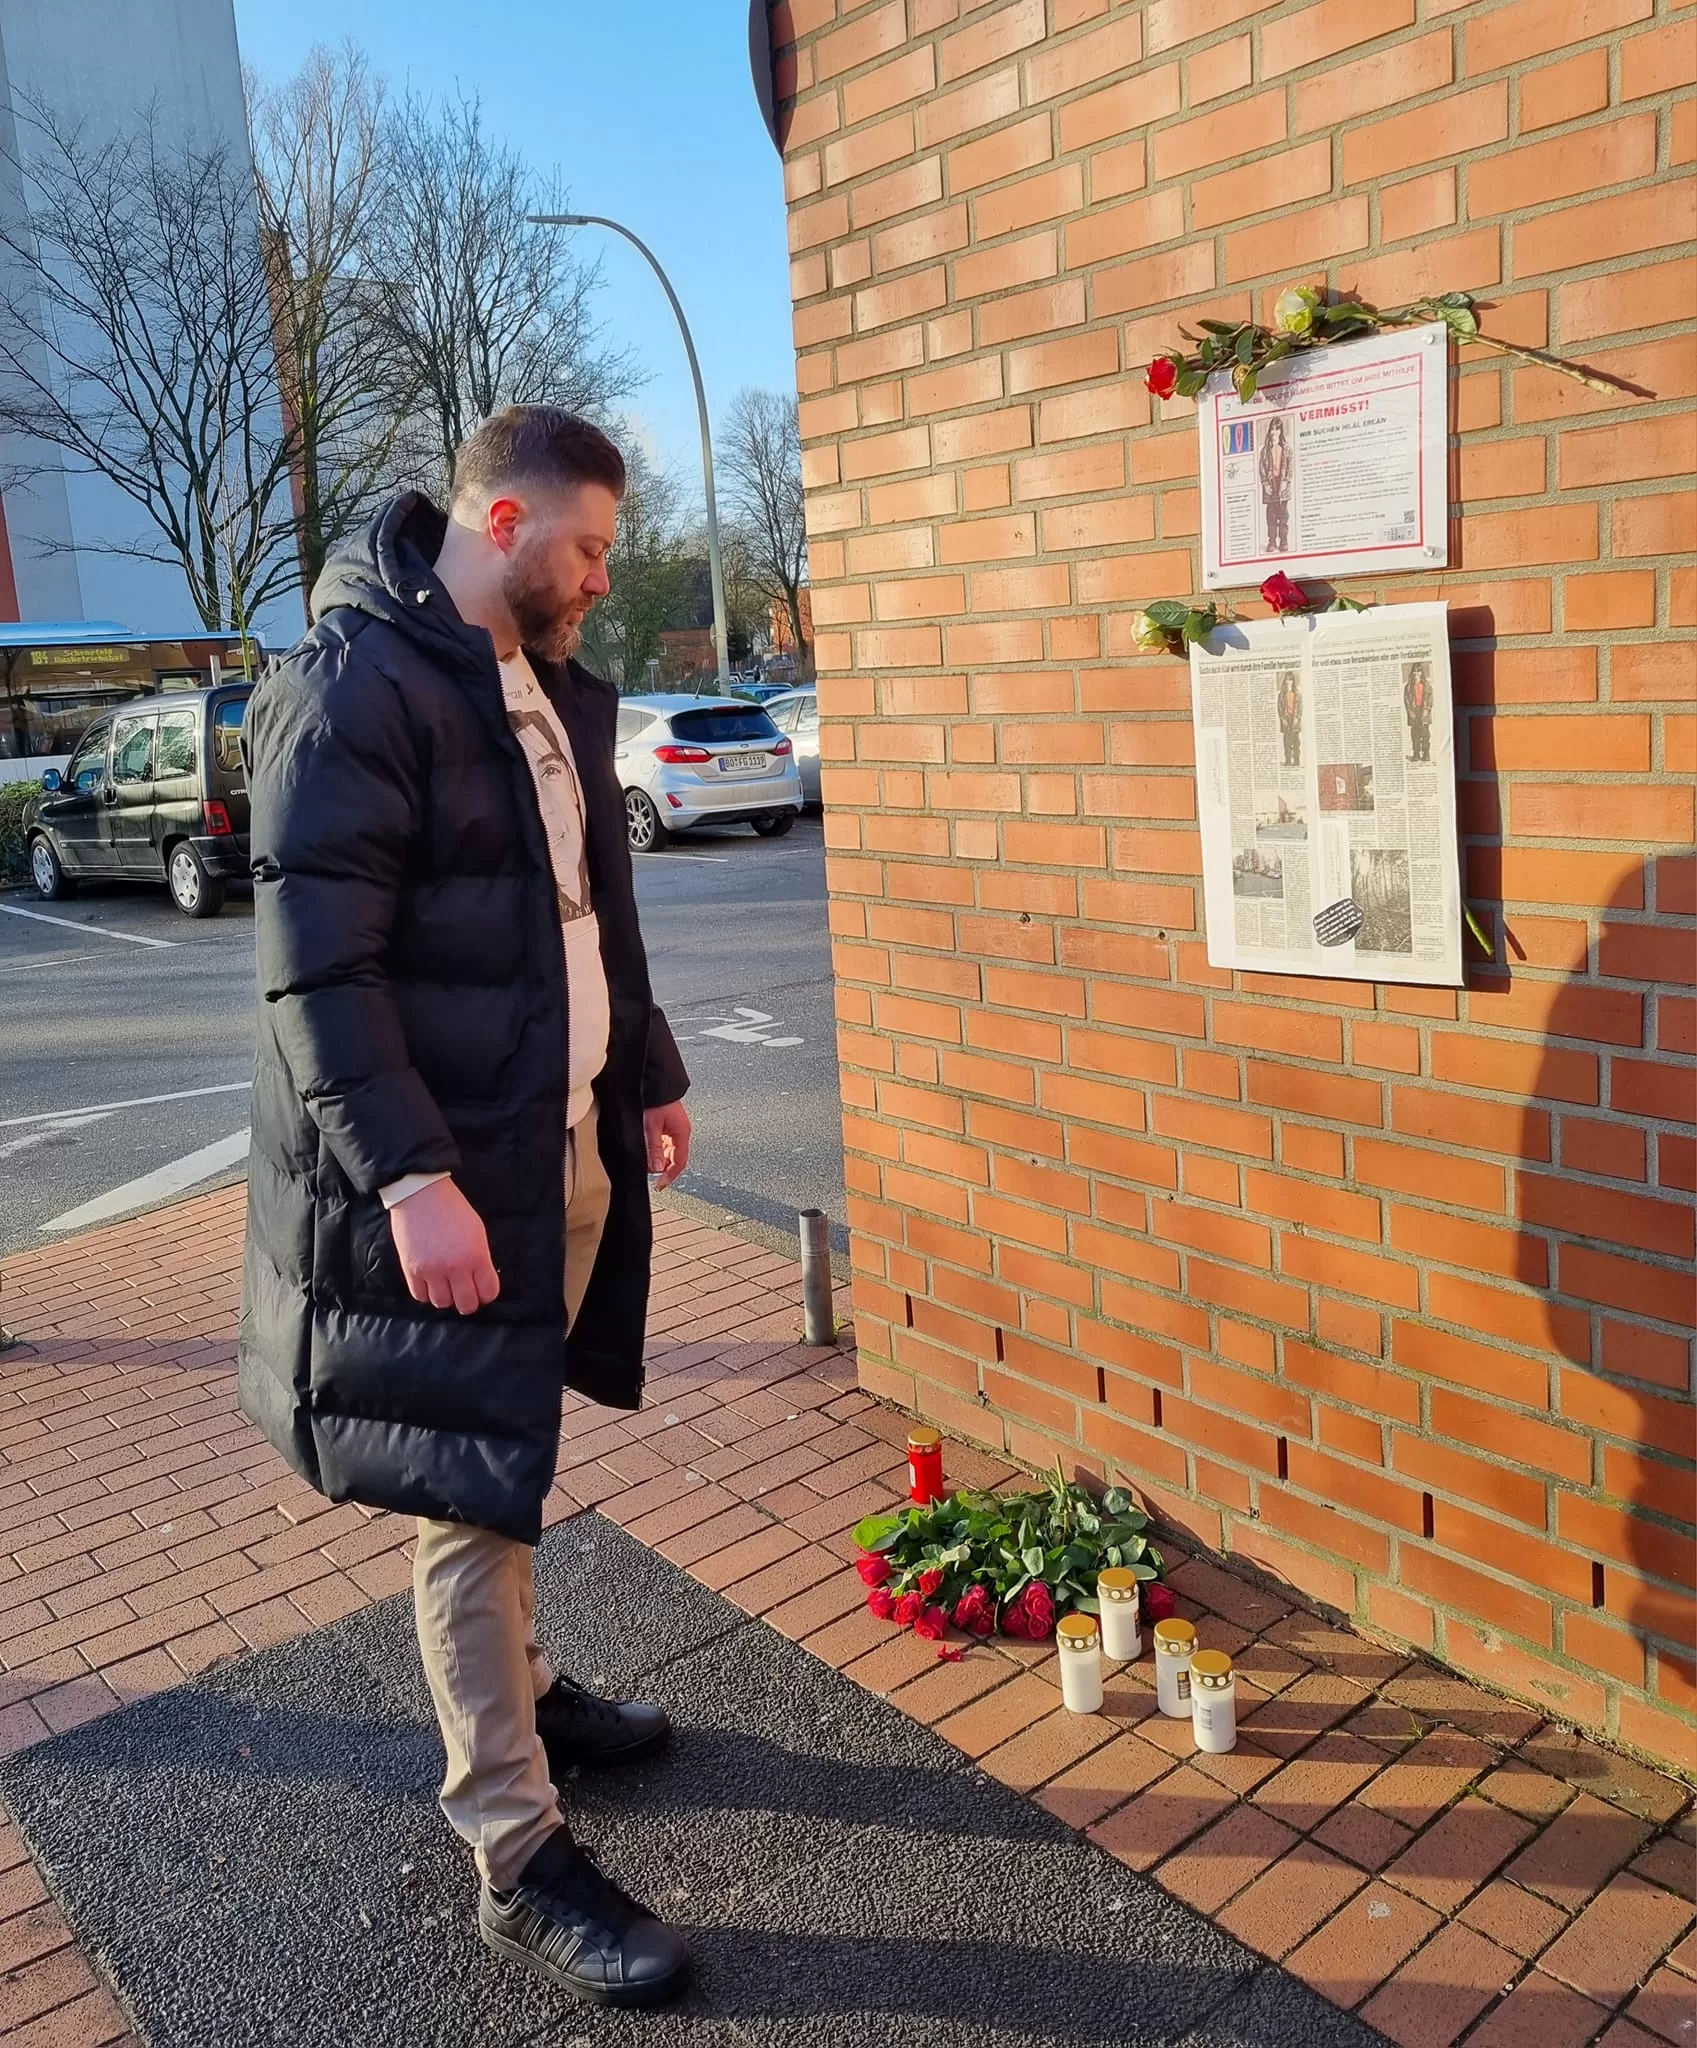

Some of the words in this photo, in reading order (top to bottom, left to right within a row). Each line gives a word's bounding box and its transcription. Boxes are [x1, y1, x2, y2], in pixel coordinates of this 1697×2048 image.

[1299, 399, 1369, 422] VERMISST!
[1299, 429, 1312, 438] WIR
[1313, 425, 1341, 437] SUCHEN
[1363, 417, 1387, 428] ERCAN
